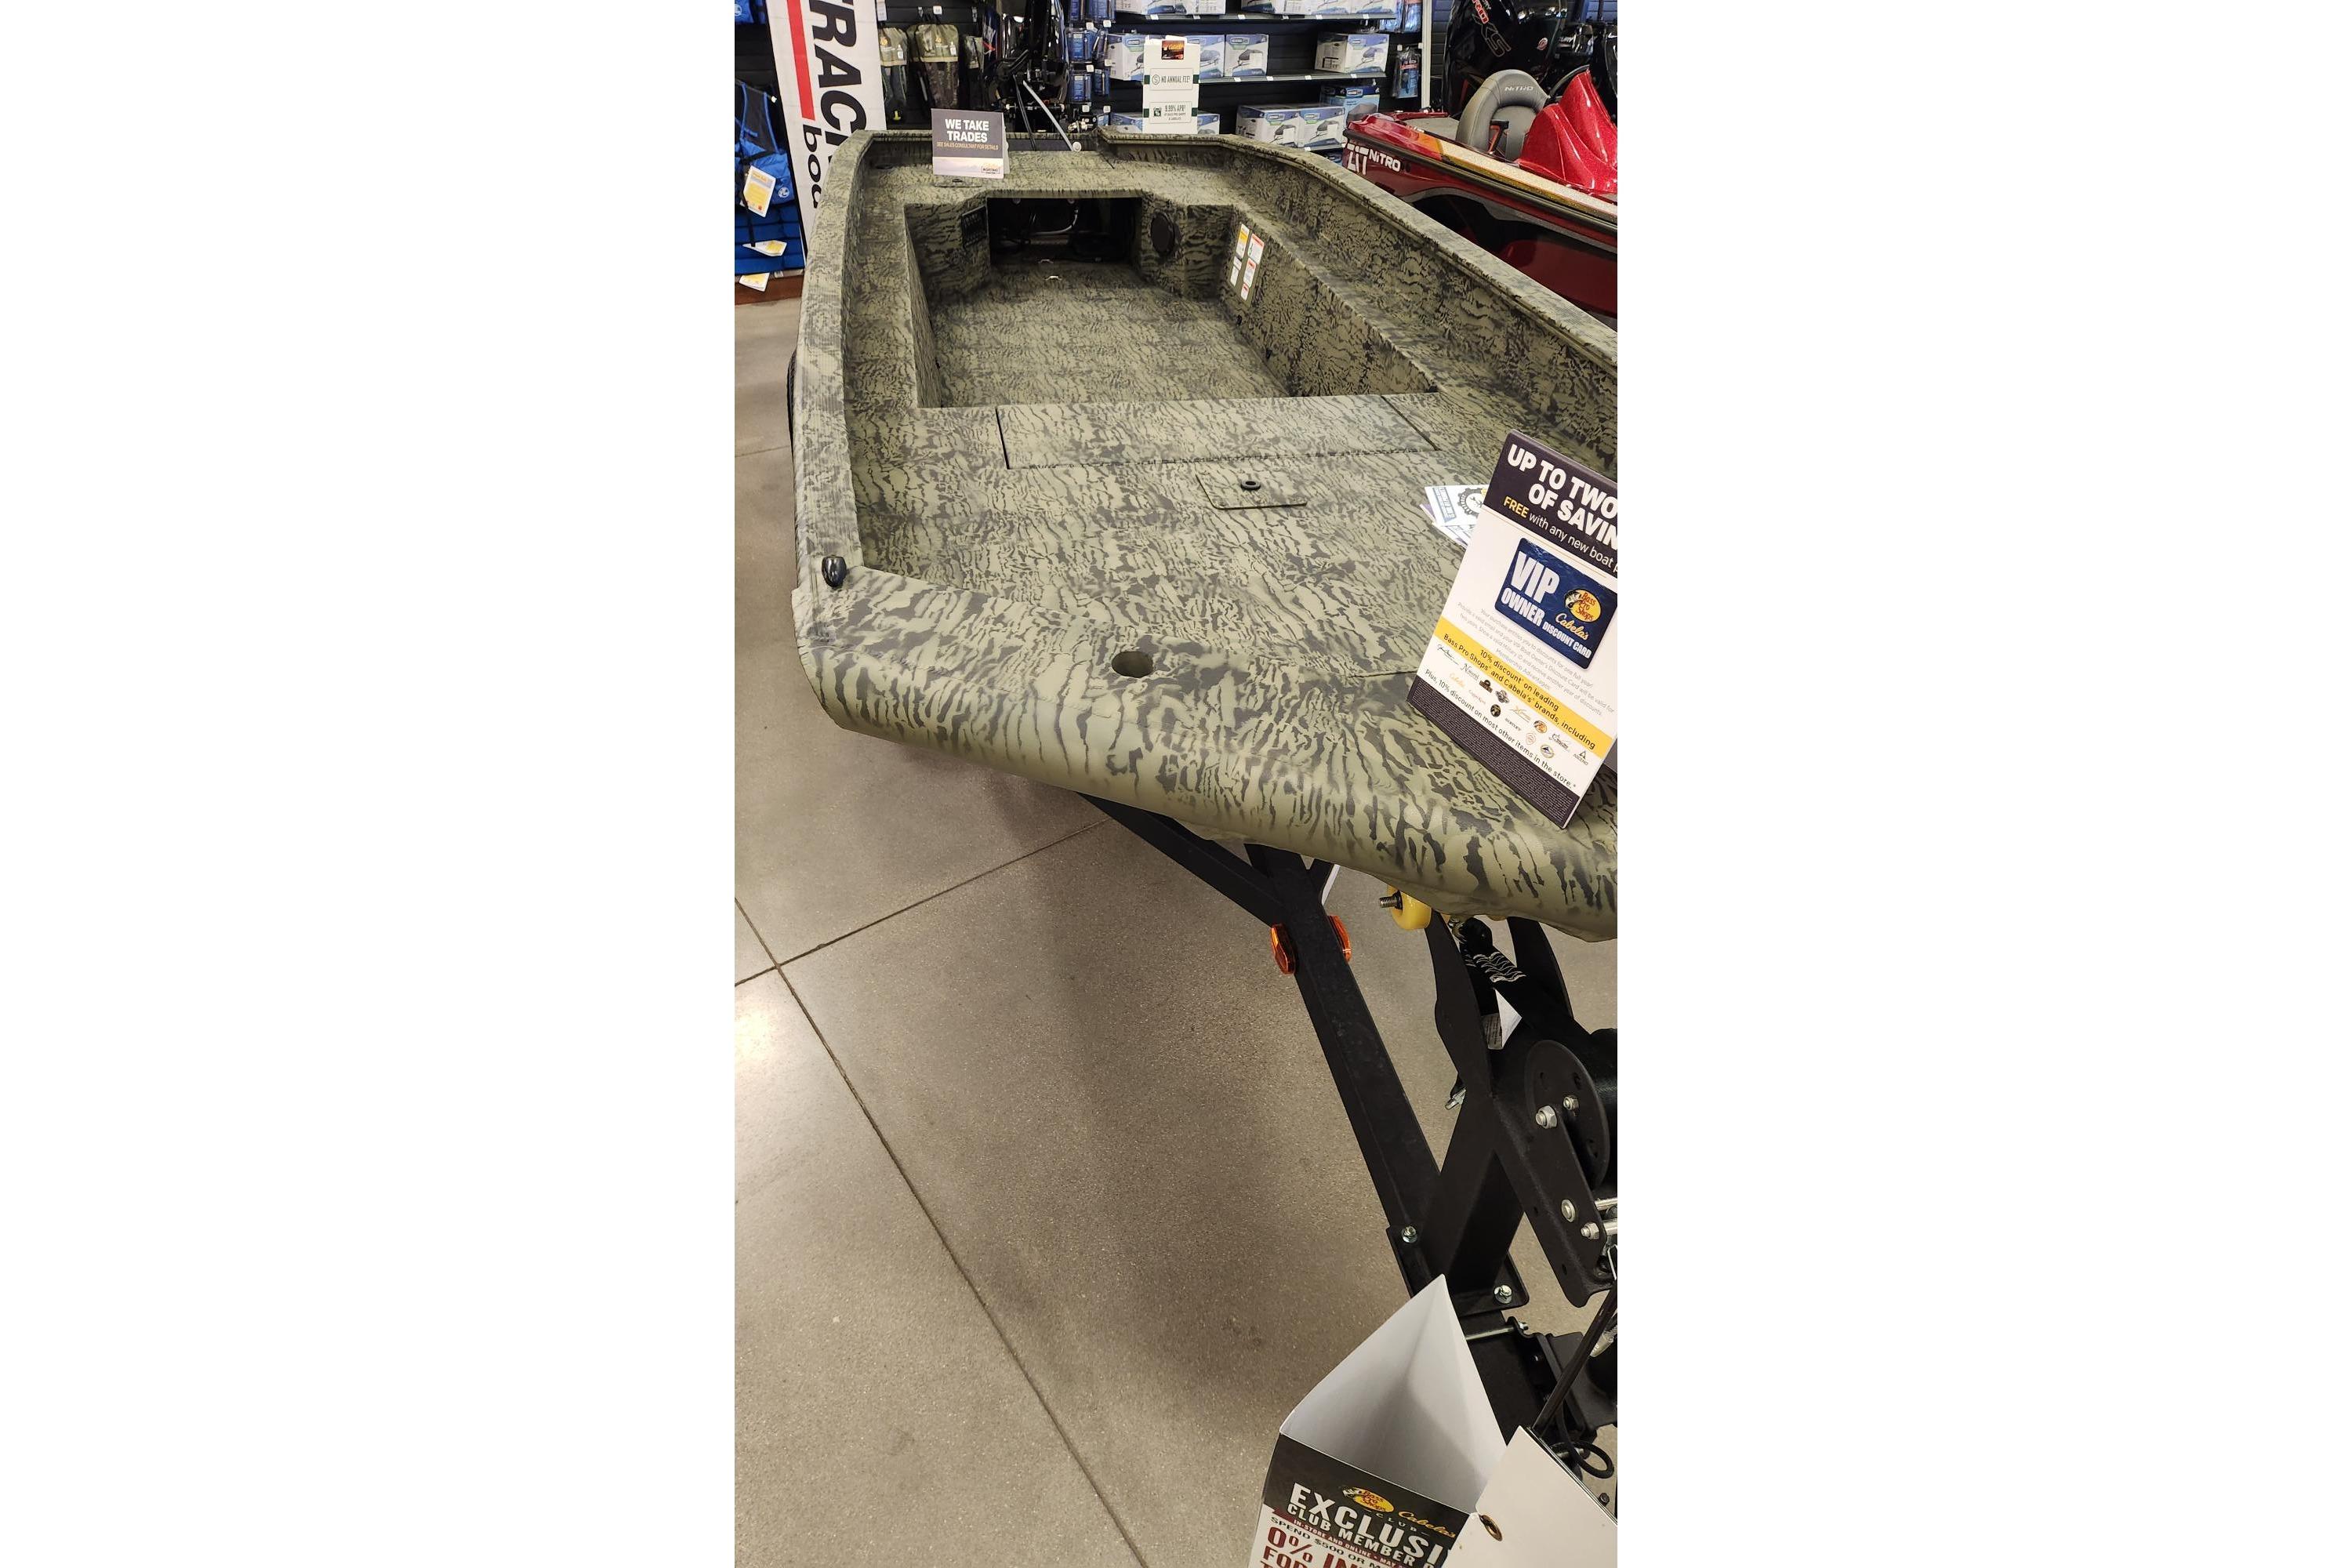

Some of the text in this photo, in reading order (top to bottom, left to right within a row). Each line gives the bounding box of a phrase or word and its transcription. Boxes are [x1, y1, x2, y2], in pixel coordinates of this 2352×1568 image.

[945, 119, 989, 131] WE TAKE
[947, 130, 988, 143] TRADES
[1508, 444, 1617, 519] UP TO TWO
[1529, 483, 1559, 510] OF
[1504, 495, 1529, 518] FREE
[1530, 513, 1549, 530] with
[1549, 525, 1568, 543] any
[1568, 536, 1590, 554] new
[1589, 546, 1613, 568] boat
[1511, 550, 1560, 604] VIP
[1501, 588, 1545, 627] OWNER
[1576, 607, 1594, 621] Shops
[1581, 592, 1596, 606] Bass
[1581, 600, 1590, 610] Pro
[1542, 621, 1592, 659] DISCOUNT CARD
[1444, 633, 1457, 648] Bass
[1459, 645, 1468, 655] Pro
[1491, 671, 1504, 681] and
[1535, 701, 1559, 724] brands,
[1562, 721, 1595, 750] including
[1481, 650, 1492, 662] 10%
[1534, 688, 1559, 711] leading
[1425, 670, 1437, 683] Plus,
[1439, 680, 1449, 691] 10%
[1450, 691, 1474, 711] discount
[1483, 717, 1497, 730] most
[1499, 729, 1515, 742] other
[1515, 741, 1533, 757] items
[1542, 761, 1552, 772] the
[1270, 1516, 1366, 1565] SPEND $500 OR
[1287, 1504, 1416, 1566] CLUB MEMBER
[1375, 1513, 1417, 1532] CLUB
[1267, 1526, 1314, 1563] 0%
[1294, 1519, 1325, 1538] IN-STORE
[1328, 1535, 1344, 1547] AND
[1345, 1541, 1372, 1557] ONLINE
[1380, 1555, 1396, 1566] MAY
